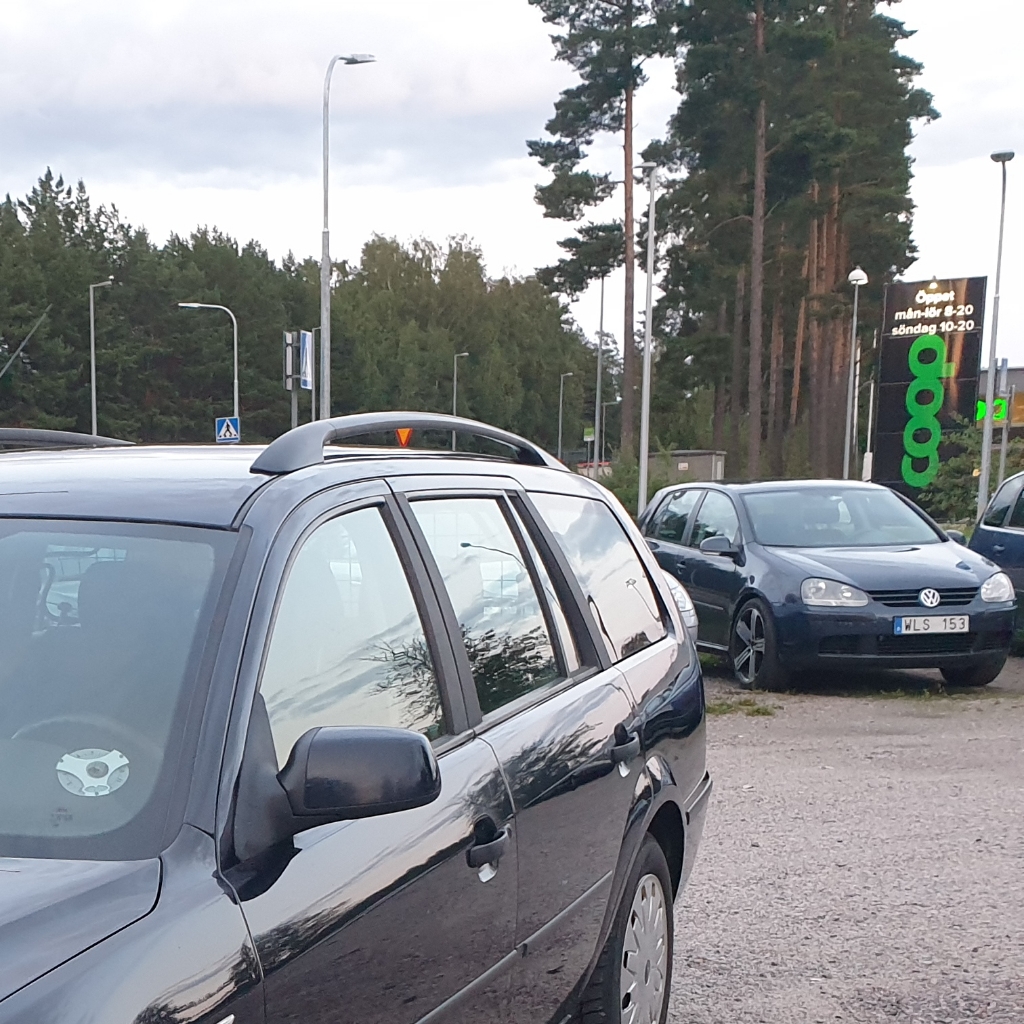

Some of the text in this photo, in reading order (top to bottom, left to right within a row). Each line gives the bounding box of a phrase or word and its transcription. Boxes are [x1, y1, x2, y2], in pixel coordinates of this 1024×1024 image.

[915, 290, 955, 304] Öppet
[894, 305, 974, 320] mån-lör 8-20
[891, 320, 975, 335] söndag 10-20
[901, 334, 956, 487] coop
[904, 618, 966, 631] WLS 153
